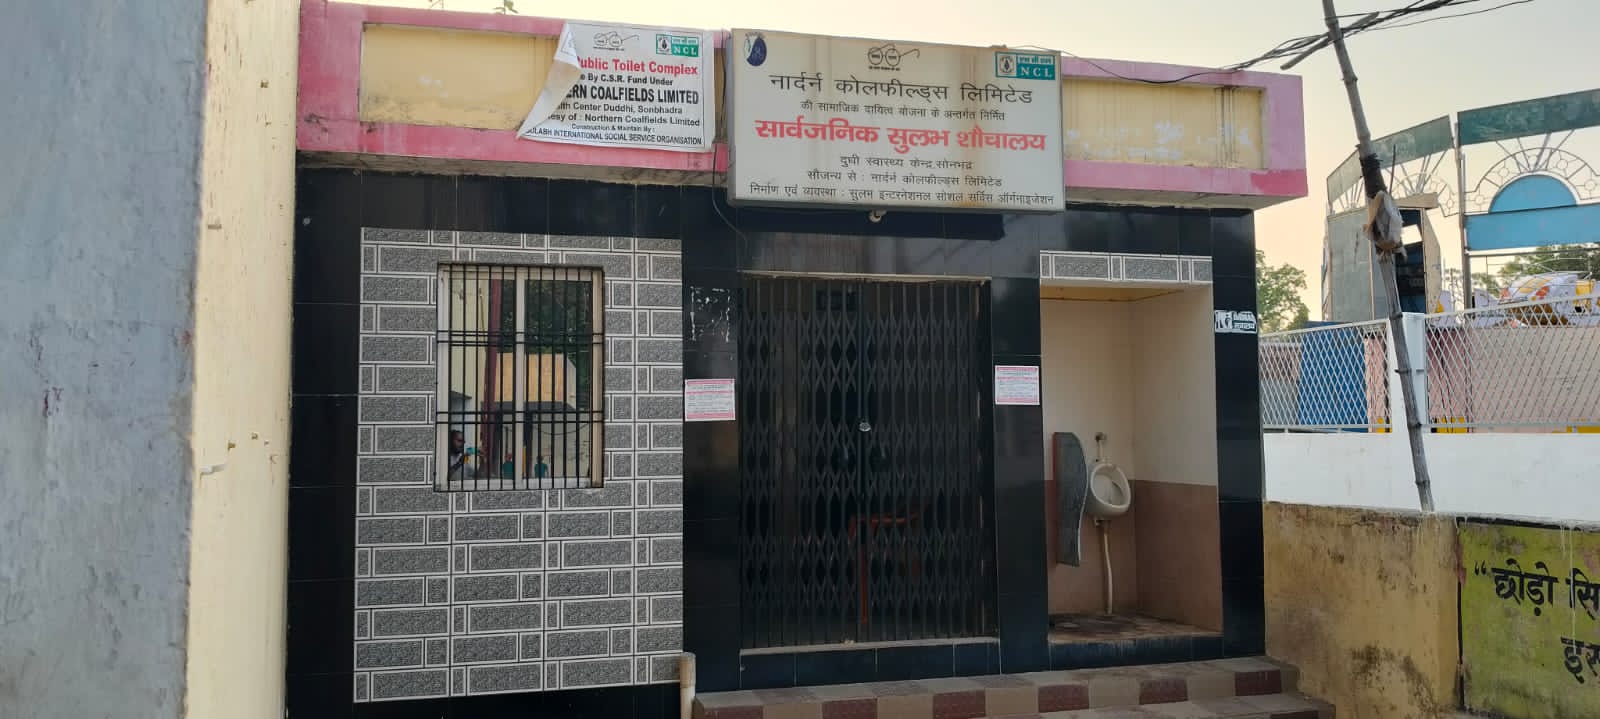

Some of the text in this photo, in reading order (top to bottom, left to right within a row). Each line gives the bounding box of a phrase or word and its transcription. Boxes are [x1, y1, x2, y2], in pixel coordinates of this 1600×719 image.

[614, 59, 645, 71] Toilet
[649, 61, 697, 77] Complex
[588, 74, 598, 83] By
[601, 74, 625, 83] C.S.R.
[627, 76, 647, 84] Fund
[650, 77, 673, 86] Under
[591, 87, 655, 102] COALFIELDS
[658, 90, 698, 104] LIMITED
[961, 82, 1033, 104] लिमिटेड
[573, 103, 601, 111] Center
[604, 104, 634, 113] Duddhi,
[638, 106, 682, 114] Sonbhadra
[818, 101, 859, 113] सामाजिक
[568, 113, 577, 121] of
[585, 115, 623, 123] Northern
[625, 115, 667, 124] Coalfields
[670, 118, 700, 126] Limited
[553, 129, 604, 140] INTERNATIONAL
[605, 133, 627, 141] SOCIAL
[629, 134, 656, 143] SERVICE
[657, 135, 702, 145] ORGANISATION
[755, 116, 1046, 154] सार्वजनिक सुलभ शौचालय
[965, 176, 1002, 187] लिमिटेड
